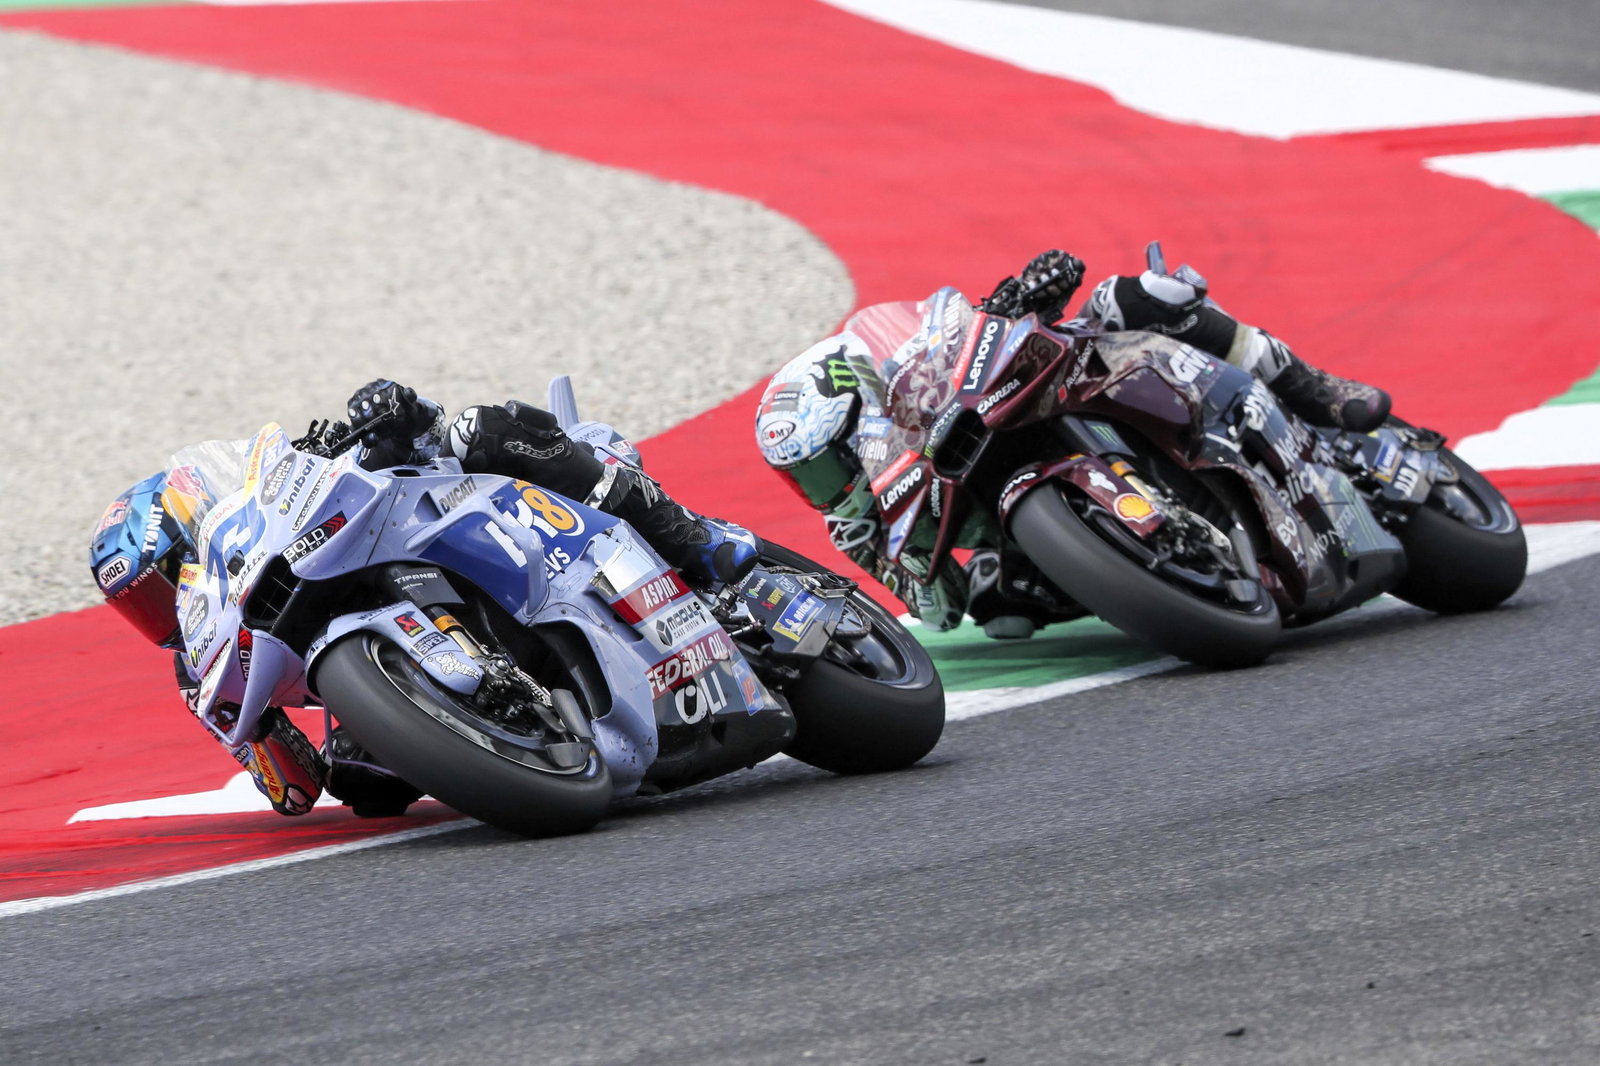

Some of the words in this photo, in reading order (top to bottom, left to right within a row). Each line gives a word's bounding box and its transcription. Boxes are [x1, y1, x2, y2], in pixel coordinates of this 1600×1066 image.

[963, 321, 998, 390] Lenovo
[774, 392, 798, 400] Lenovo
[977, 379, 1021, 414] CARRERA
[762, 426, 791, 441] UOMY
[279, 458, 316, 516] Unibat
[438, 475, 478, 513] DUCATI
[881, 467, 922, 511] Lenovo
[282, 527, 326, 561] BOLD
[100, 560, 126, 585] SHOEI
[130, 562, 158, 588] WINGS
[641, 577, 680, 609] ASPIRA
[667, 601, 701, 632] MODUL
[419, 635, 446, 655] SIPEX
[644, 641, 711, 700] FEDERAL
